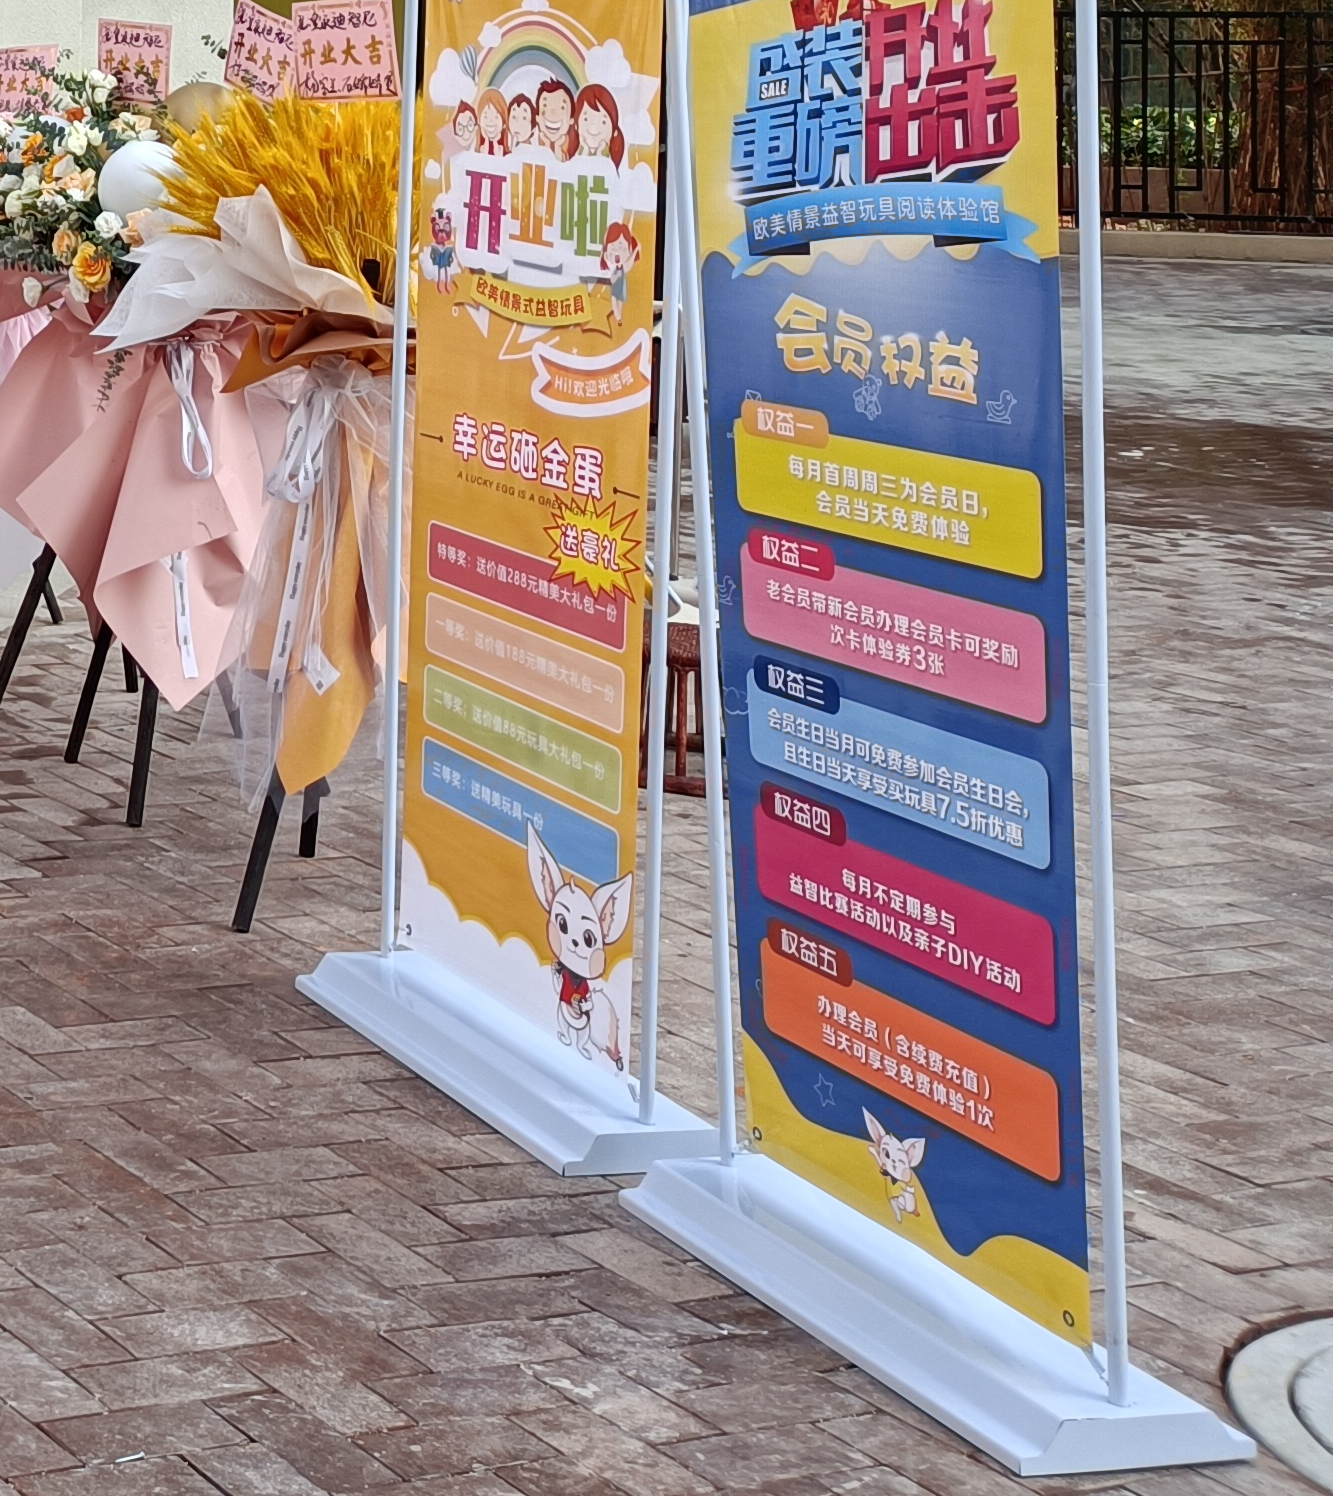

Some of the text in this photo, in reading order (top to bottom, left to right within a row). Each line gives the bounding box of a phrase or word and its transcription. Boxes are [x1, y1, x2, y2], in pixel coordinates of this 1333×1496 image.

[233, 32, 291, 81] 开业大吉
[300, 34, 385, 70] 开业大吉
[760, 79, 788, 99] SALE
[463, 162, 610, 258] 开业啦
[752, 195, 1001, 241] 欧美情景益智玩具阅读体验馆
[476, 276, 585, 318] 欧美情景式益智玩具
[773, 292, 980, 406] 会员权益
[756, 407, 815, 438] 权益一
[452, 412, 603, 501] 幸运砸金蛋
[457, 470, 464, 480] A
[465, 472, 494, 488] LUCKY
[517, 489, 527, 500] IS
[528, 493, 535, 503] A
[815, 489, 971, 546] 会员当天免费体验
[559, 522, 621, 572] 送豪礼
[761, 534, 821, 573] 权益二
[766, 578, 1020, 669] 老会员带新会员办理会员卡可奖励
[830, 623, 947, 677] 次卡体验券3张
[767, 663, 825, 706] 权益三
[774, 791, 832, 837] 权益四
[784, 741, 1024, 849] 且生日当天享受买玩具7.5折优惠
[841, 868, 956, 935] 每月不定期参与
[780, 927, 838, 978] 权益五
[789, 872, 1022, 994] 益智比赛活动以及亲子DIY活动
[821, 1022, 995, 1132] 当天可享受免费体验1次
